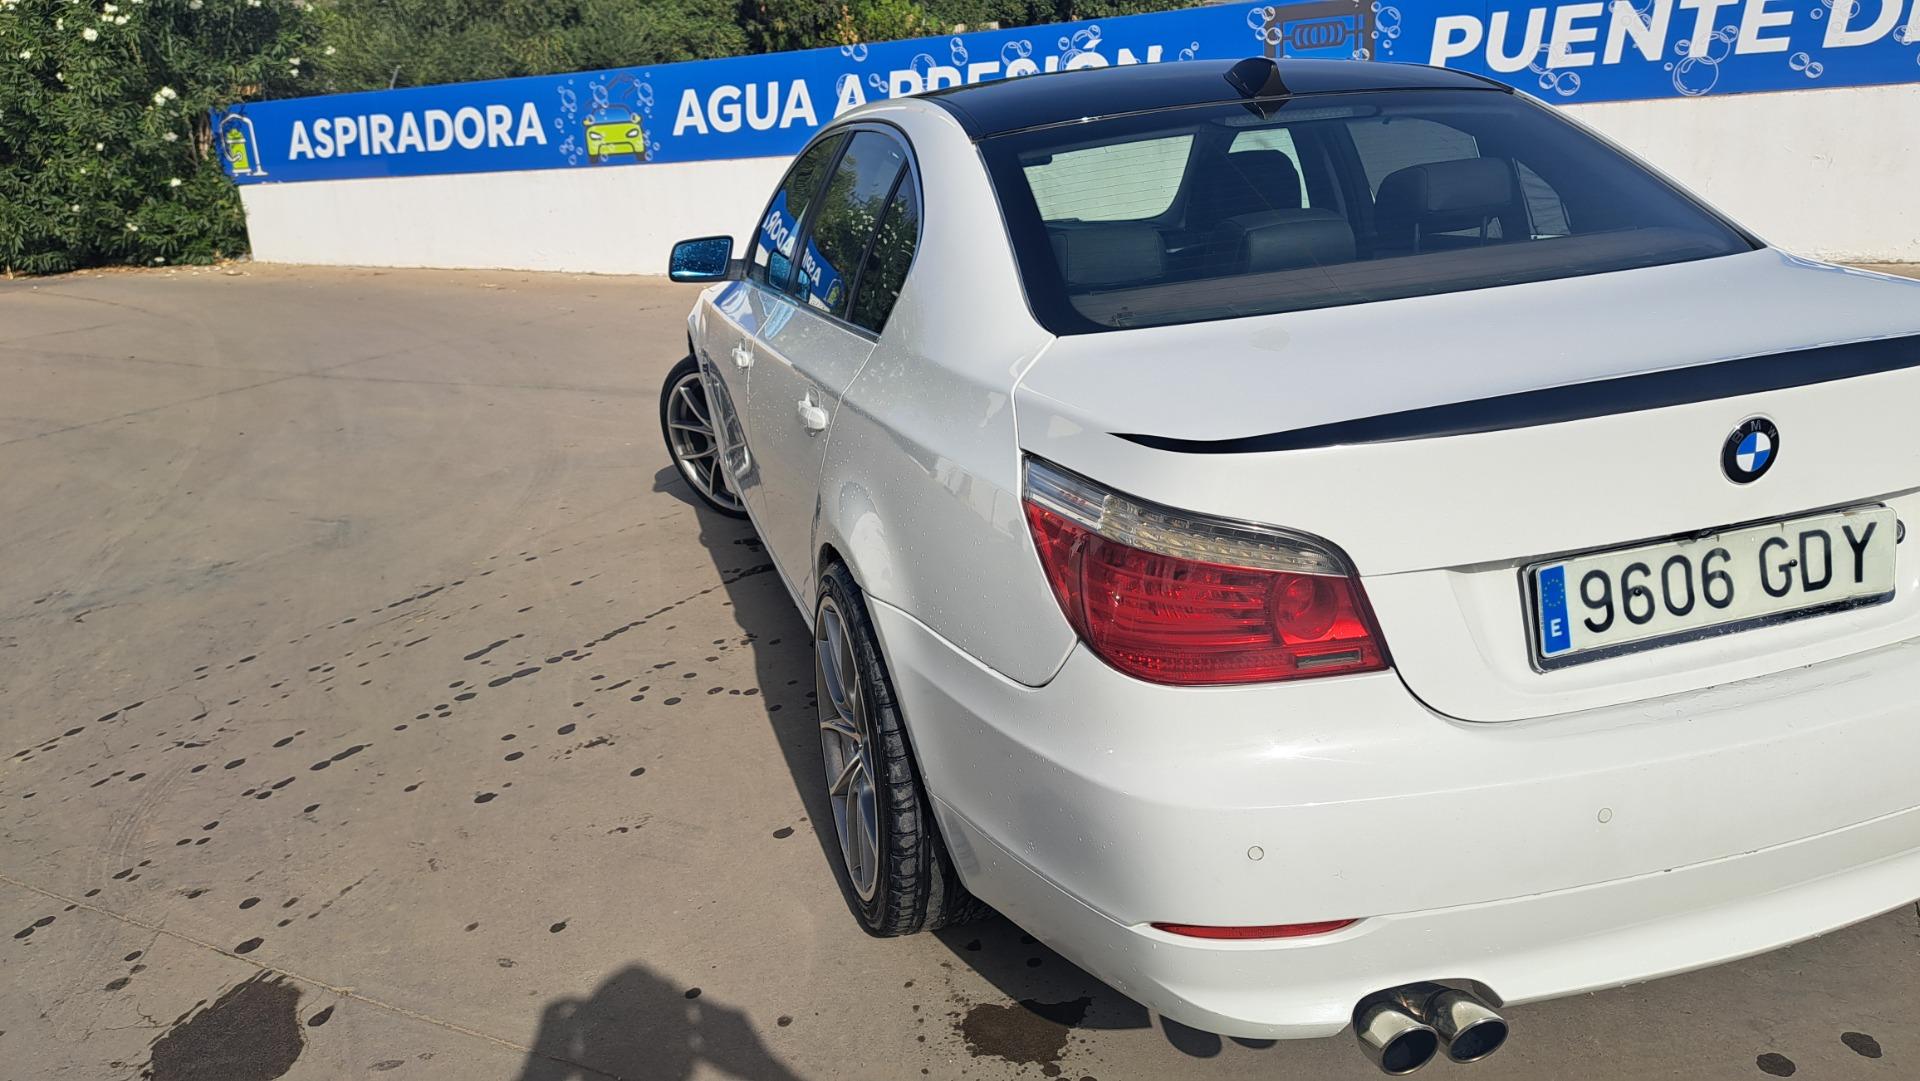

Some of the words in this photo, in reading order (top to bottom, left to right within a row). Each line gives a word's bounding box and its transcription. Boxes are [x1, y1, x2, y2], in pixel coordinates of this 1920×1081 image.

[1430, 0, 1794, 73] PUENTE
[1822, 0, 1920, 48] D
[288, 102, 548, 160] ASPIRADORA
[672, 79, 818, 137] AGUA
[833, 74, 867, 119] A
[1730, 419, 1777, 444] BMW
[1580, 547, 1735, 633] 9606
[1758, 522, 1877, 598] GDY
[1550, 618, 1563, 638] E
